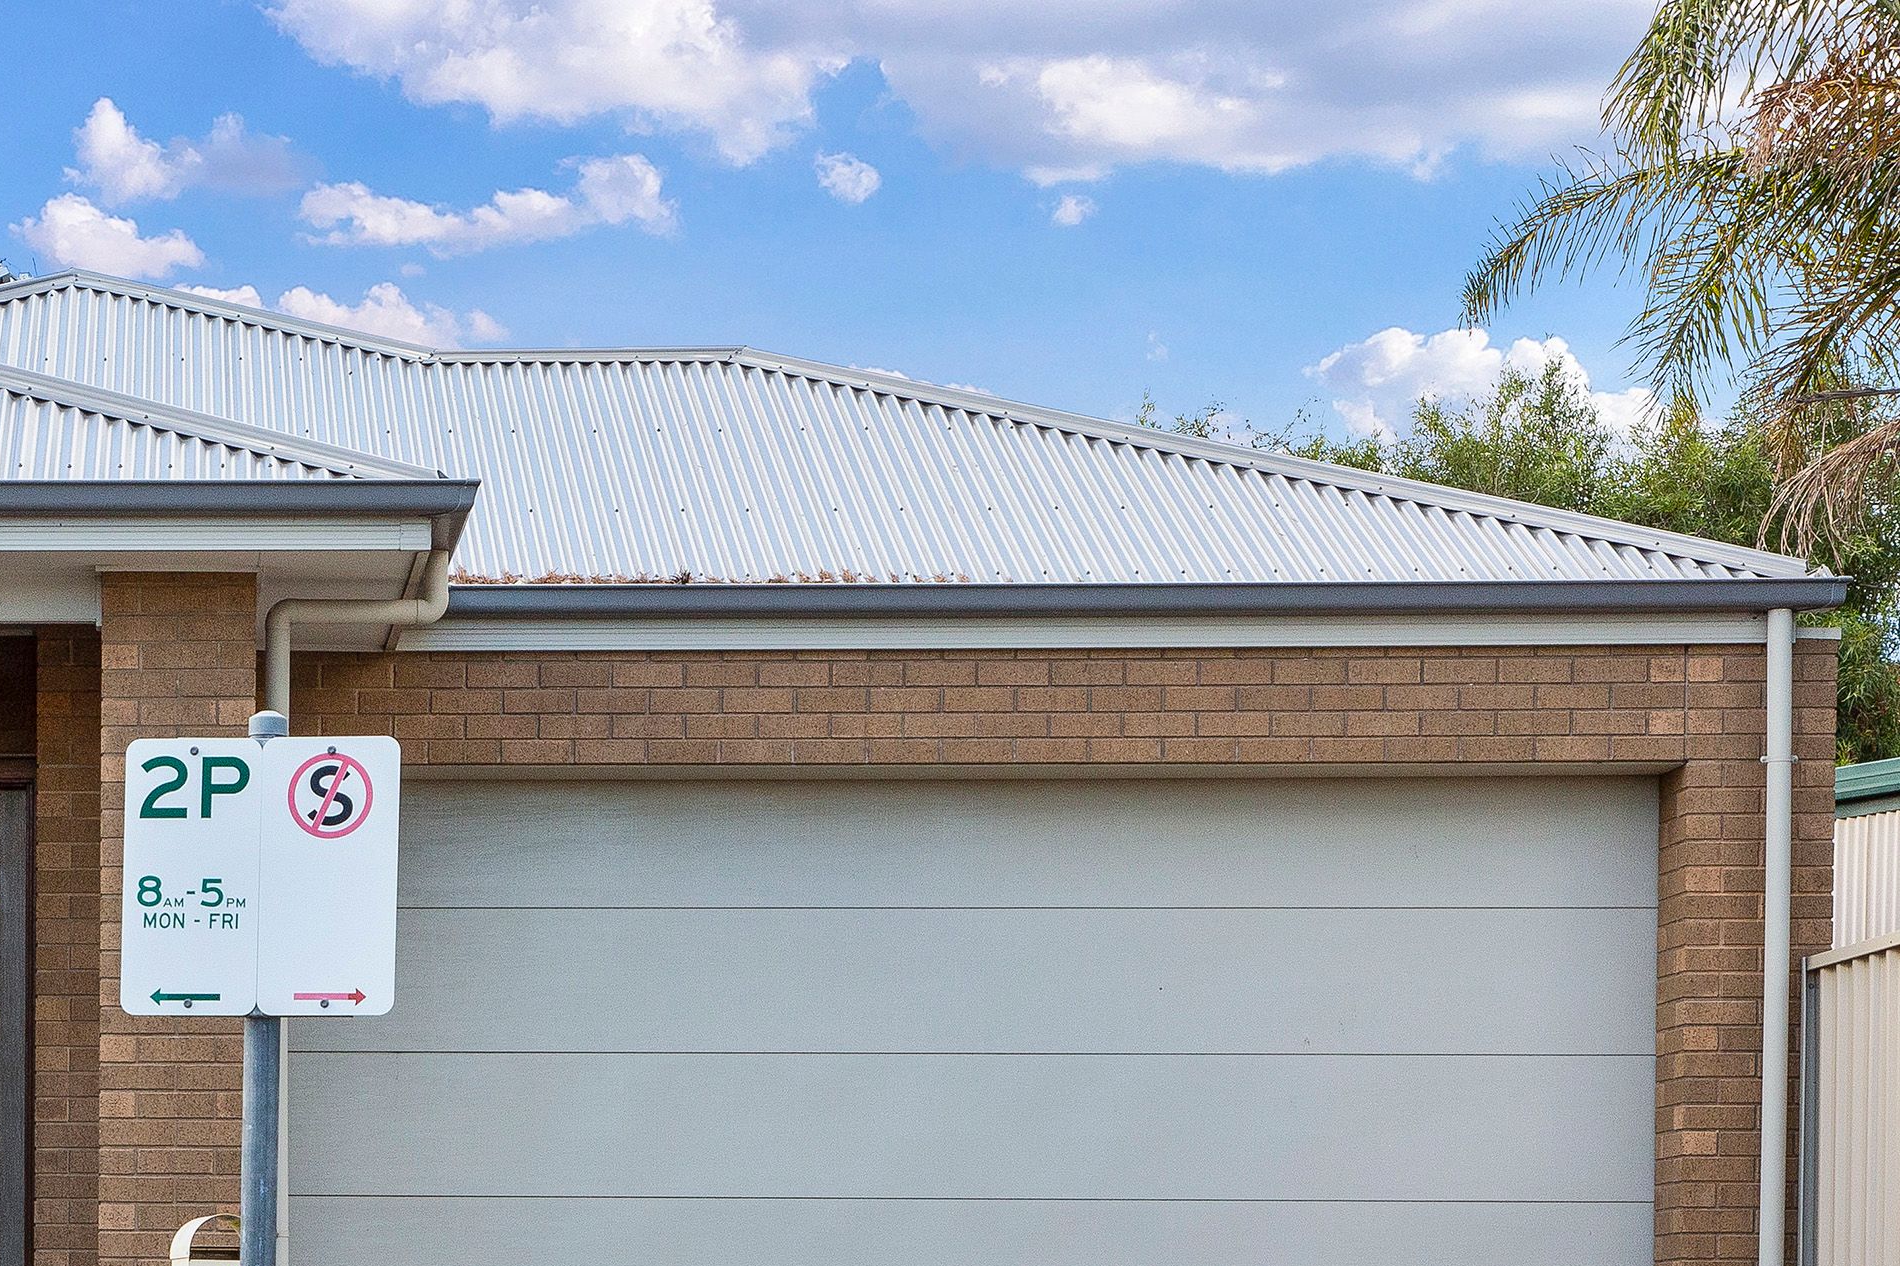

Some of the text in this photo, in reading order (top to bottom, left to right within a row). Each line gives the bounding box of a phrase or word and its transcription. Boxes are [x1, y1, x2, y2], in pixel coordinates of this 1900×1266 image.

[139, 755, 251, 819] 2P
[307, 765, 354, 826] S
[143, 913, 185, 929] MON
[209, 913, 239, 929] FRI
